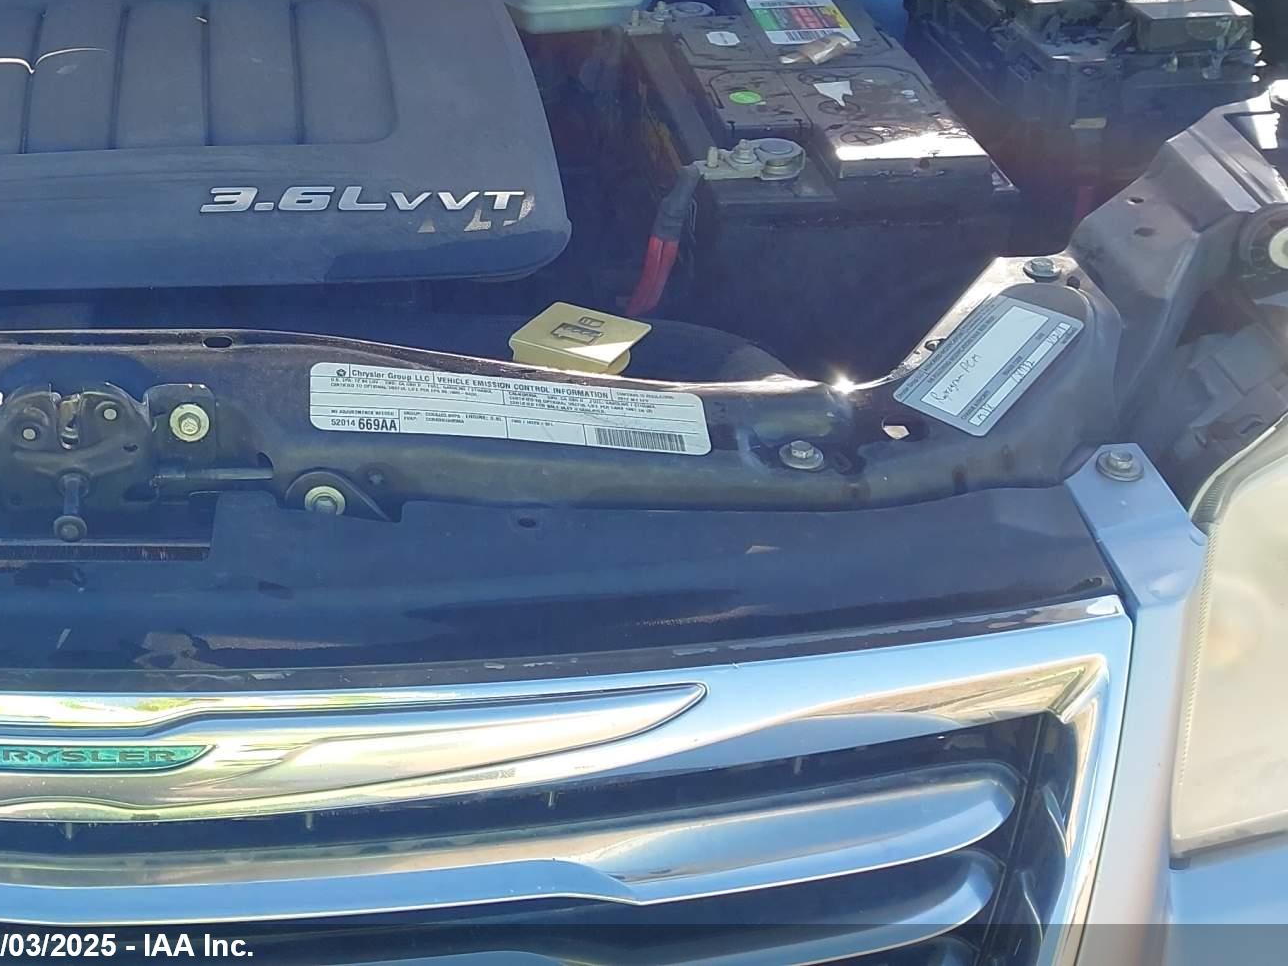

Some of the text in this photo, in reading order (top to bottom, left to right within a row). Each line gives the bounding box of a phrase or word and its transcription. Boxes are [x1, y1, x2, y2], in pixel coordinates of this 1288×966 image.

[351, 369, 430, 382] Chrysler Group LLC
[436, 375, 471, 386] VEHICLE
[472, 379, 511, 390] EMISSION
[513, 383, 550, 394] CONTROL
[552, 387, 610, 400] INFORMATION
[330, 418, 398, 432] 52014 669AA
